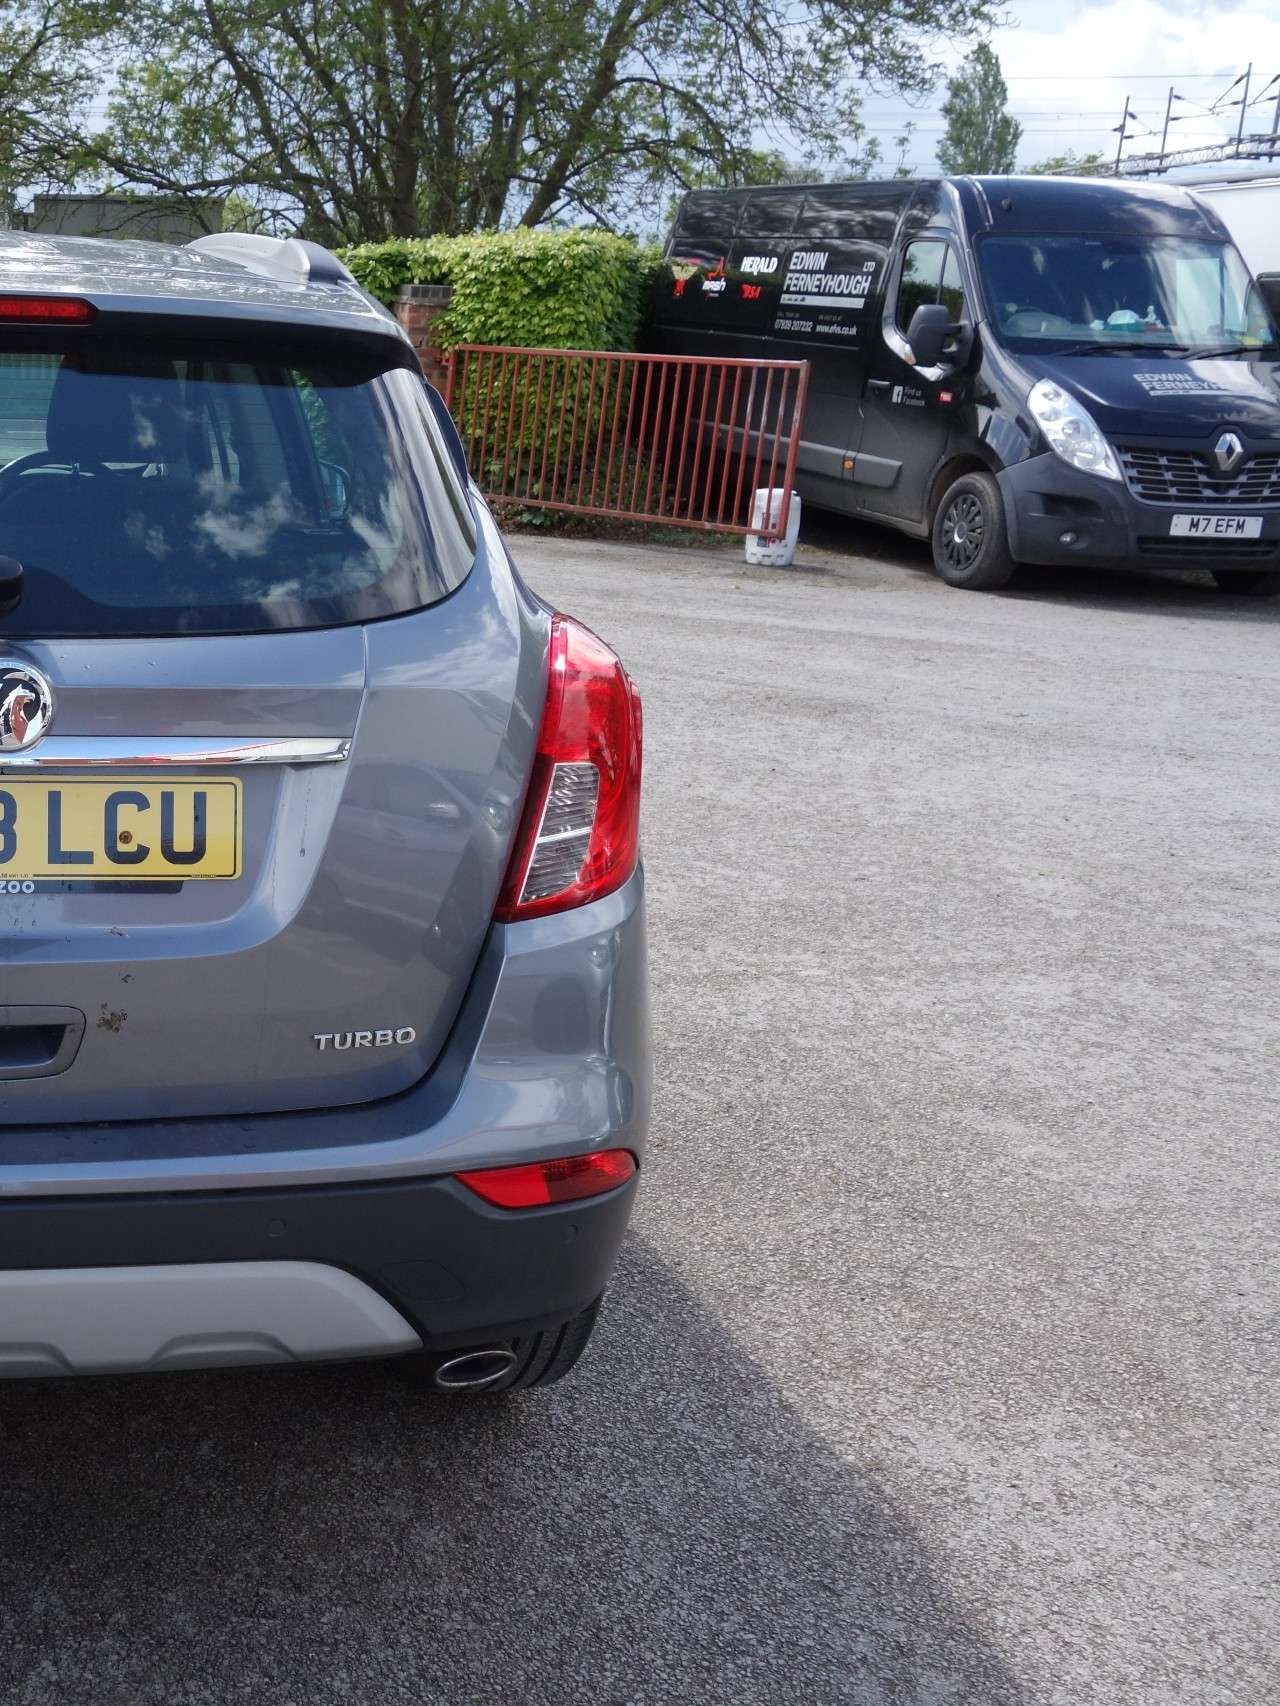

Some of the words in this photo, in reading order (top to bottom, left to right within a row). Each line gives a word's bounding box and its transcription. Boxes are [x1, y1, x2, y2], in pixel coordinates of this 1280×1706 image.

[741, 256, 778, 276] HERALD
[789, 252, 828, 270] EDWIN
[863, 261, 876, 272] LTD
[783, 273, 872, 295] FERNEYHOUGH
[1133, 373, 1193, 382] EDWIN
[1188, 517, 1212, 533] M7
[1214, 518, 1246, 534] EFM
[47, 790, 208, 865] LCU
[313, 1026, 416, 1050] TURBO
